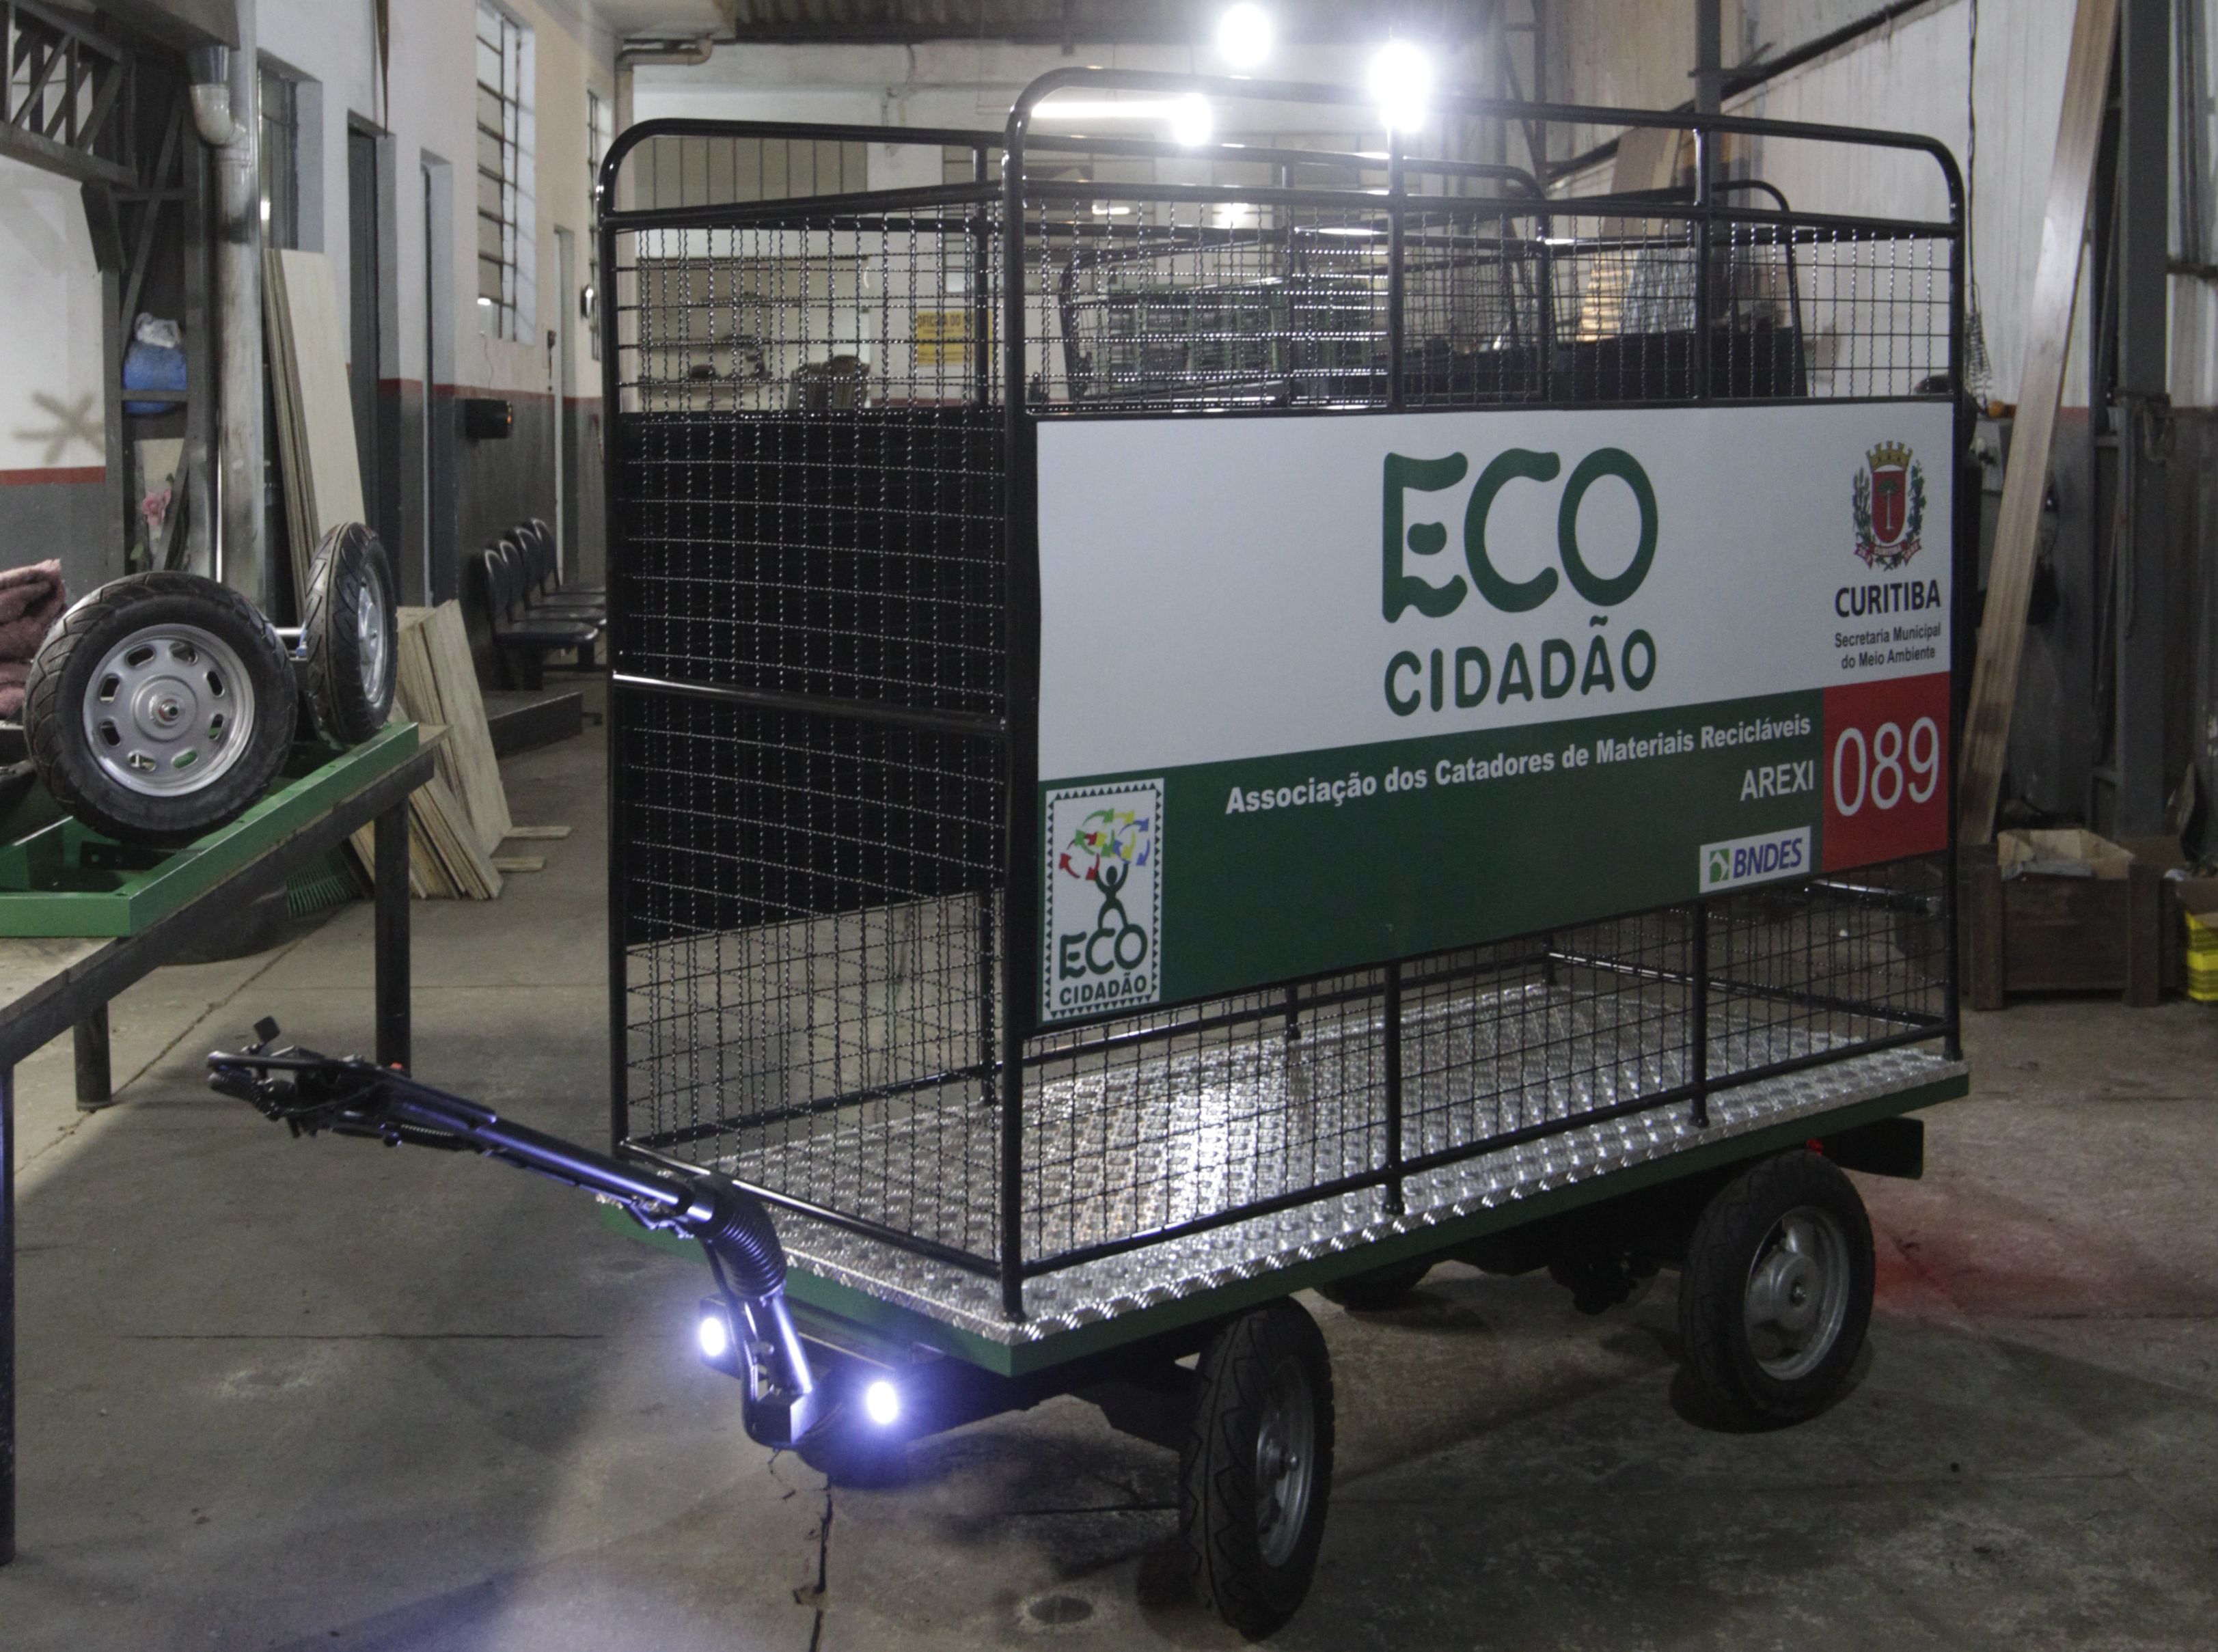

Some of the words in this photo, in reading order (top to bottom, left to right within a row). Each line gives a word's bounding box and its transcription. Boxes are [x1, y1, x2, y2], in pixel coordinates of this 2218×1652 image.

[917, 314, 948, 327] OFICA
[1382, 448, 1658, 623] ECO
[1835, 579, 1941, 618] CURITIBA
[1835, 628, 1890, 648] Secretaria
[1893, 622, 1941, 642] Municipal
[1384, 614, 1657, 717] CIDADÃO
[1841, 655, 1856, 670] do
[1859, 650, 1885, 667] Meio
[1887, 646, 1936, 664] Ambiente
[1225, 771, 1377, 815] Associação
[1384, 766, 1427, 793] dos
[1435, 752, 1555, 786] Catadores
[1561, 743, 1589, 769] de
[1596, 729, 1694, 764] Materiais
[1701, 713, 1811, 749] Recicláveis
[1740, 760, 1814, 801] AREXI
[1833, 716, 1939, 816] 089
[1733, 838, 1803, 879] BNDES
[1059, 924, 1148, 981] ECO
[1059, 972, 1147, 1006] CIDADÃO
